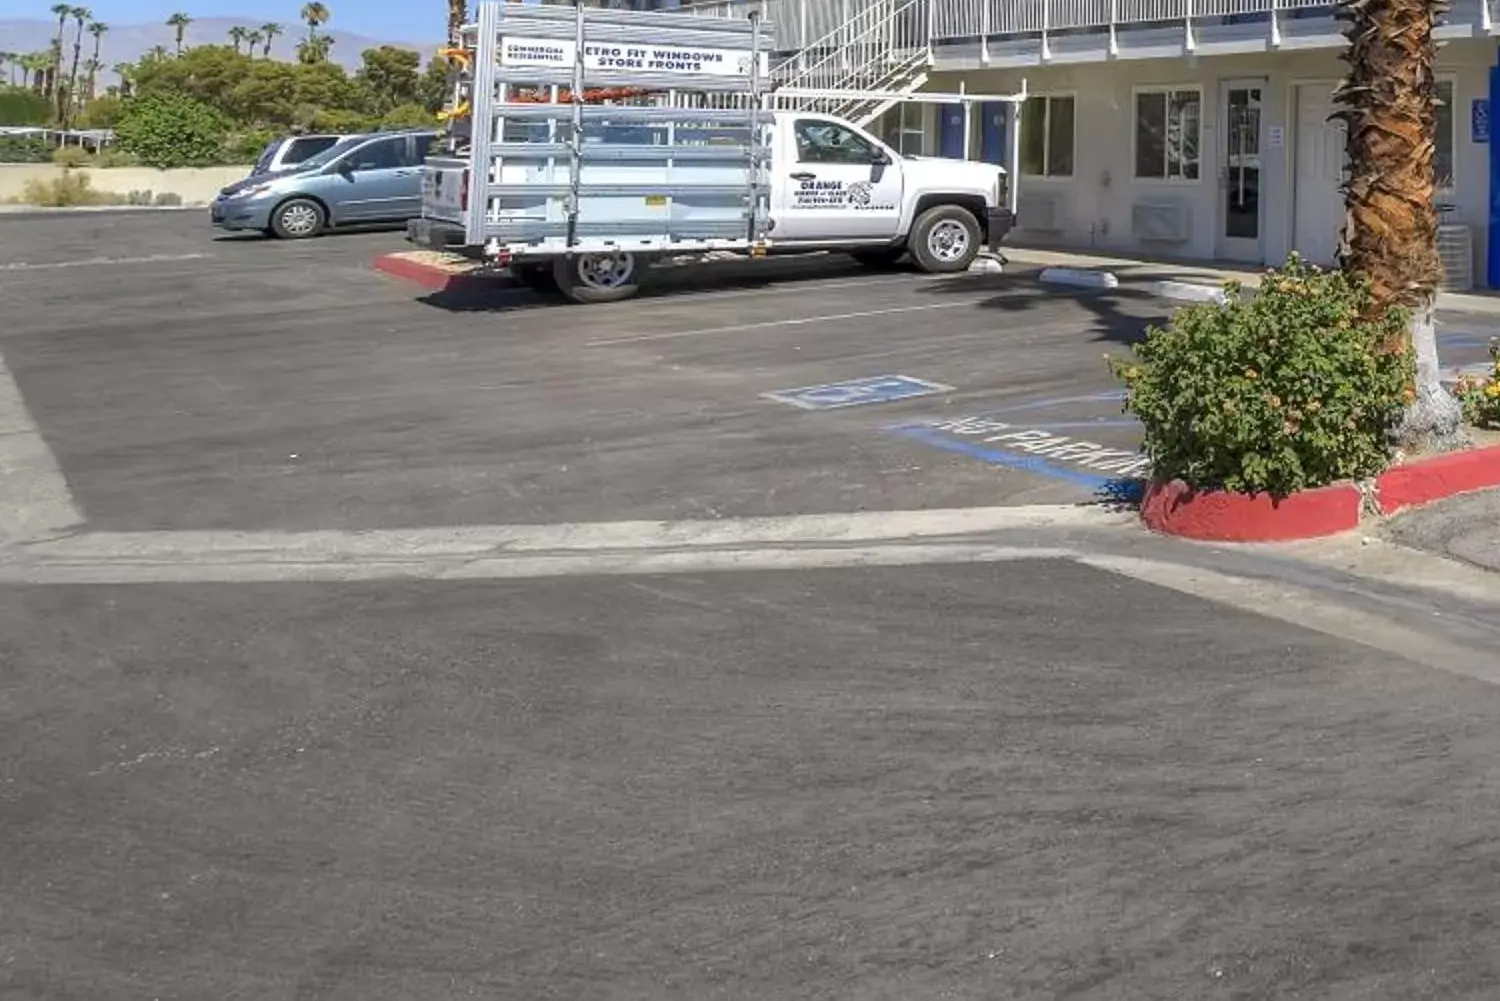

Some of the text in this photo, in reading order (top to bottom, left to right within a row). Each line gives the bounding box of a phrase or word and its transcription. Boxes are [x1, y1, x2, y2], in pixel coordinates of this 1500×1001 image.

[585, 46, 723, 62] ETRO FIT WINDOWS
[598, 57, 702, 72] STORE FRONTS
[800, 181, 842, 191] ORANGE
[983, 430, 1152, 479] PARKIN
